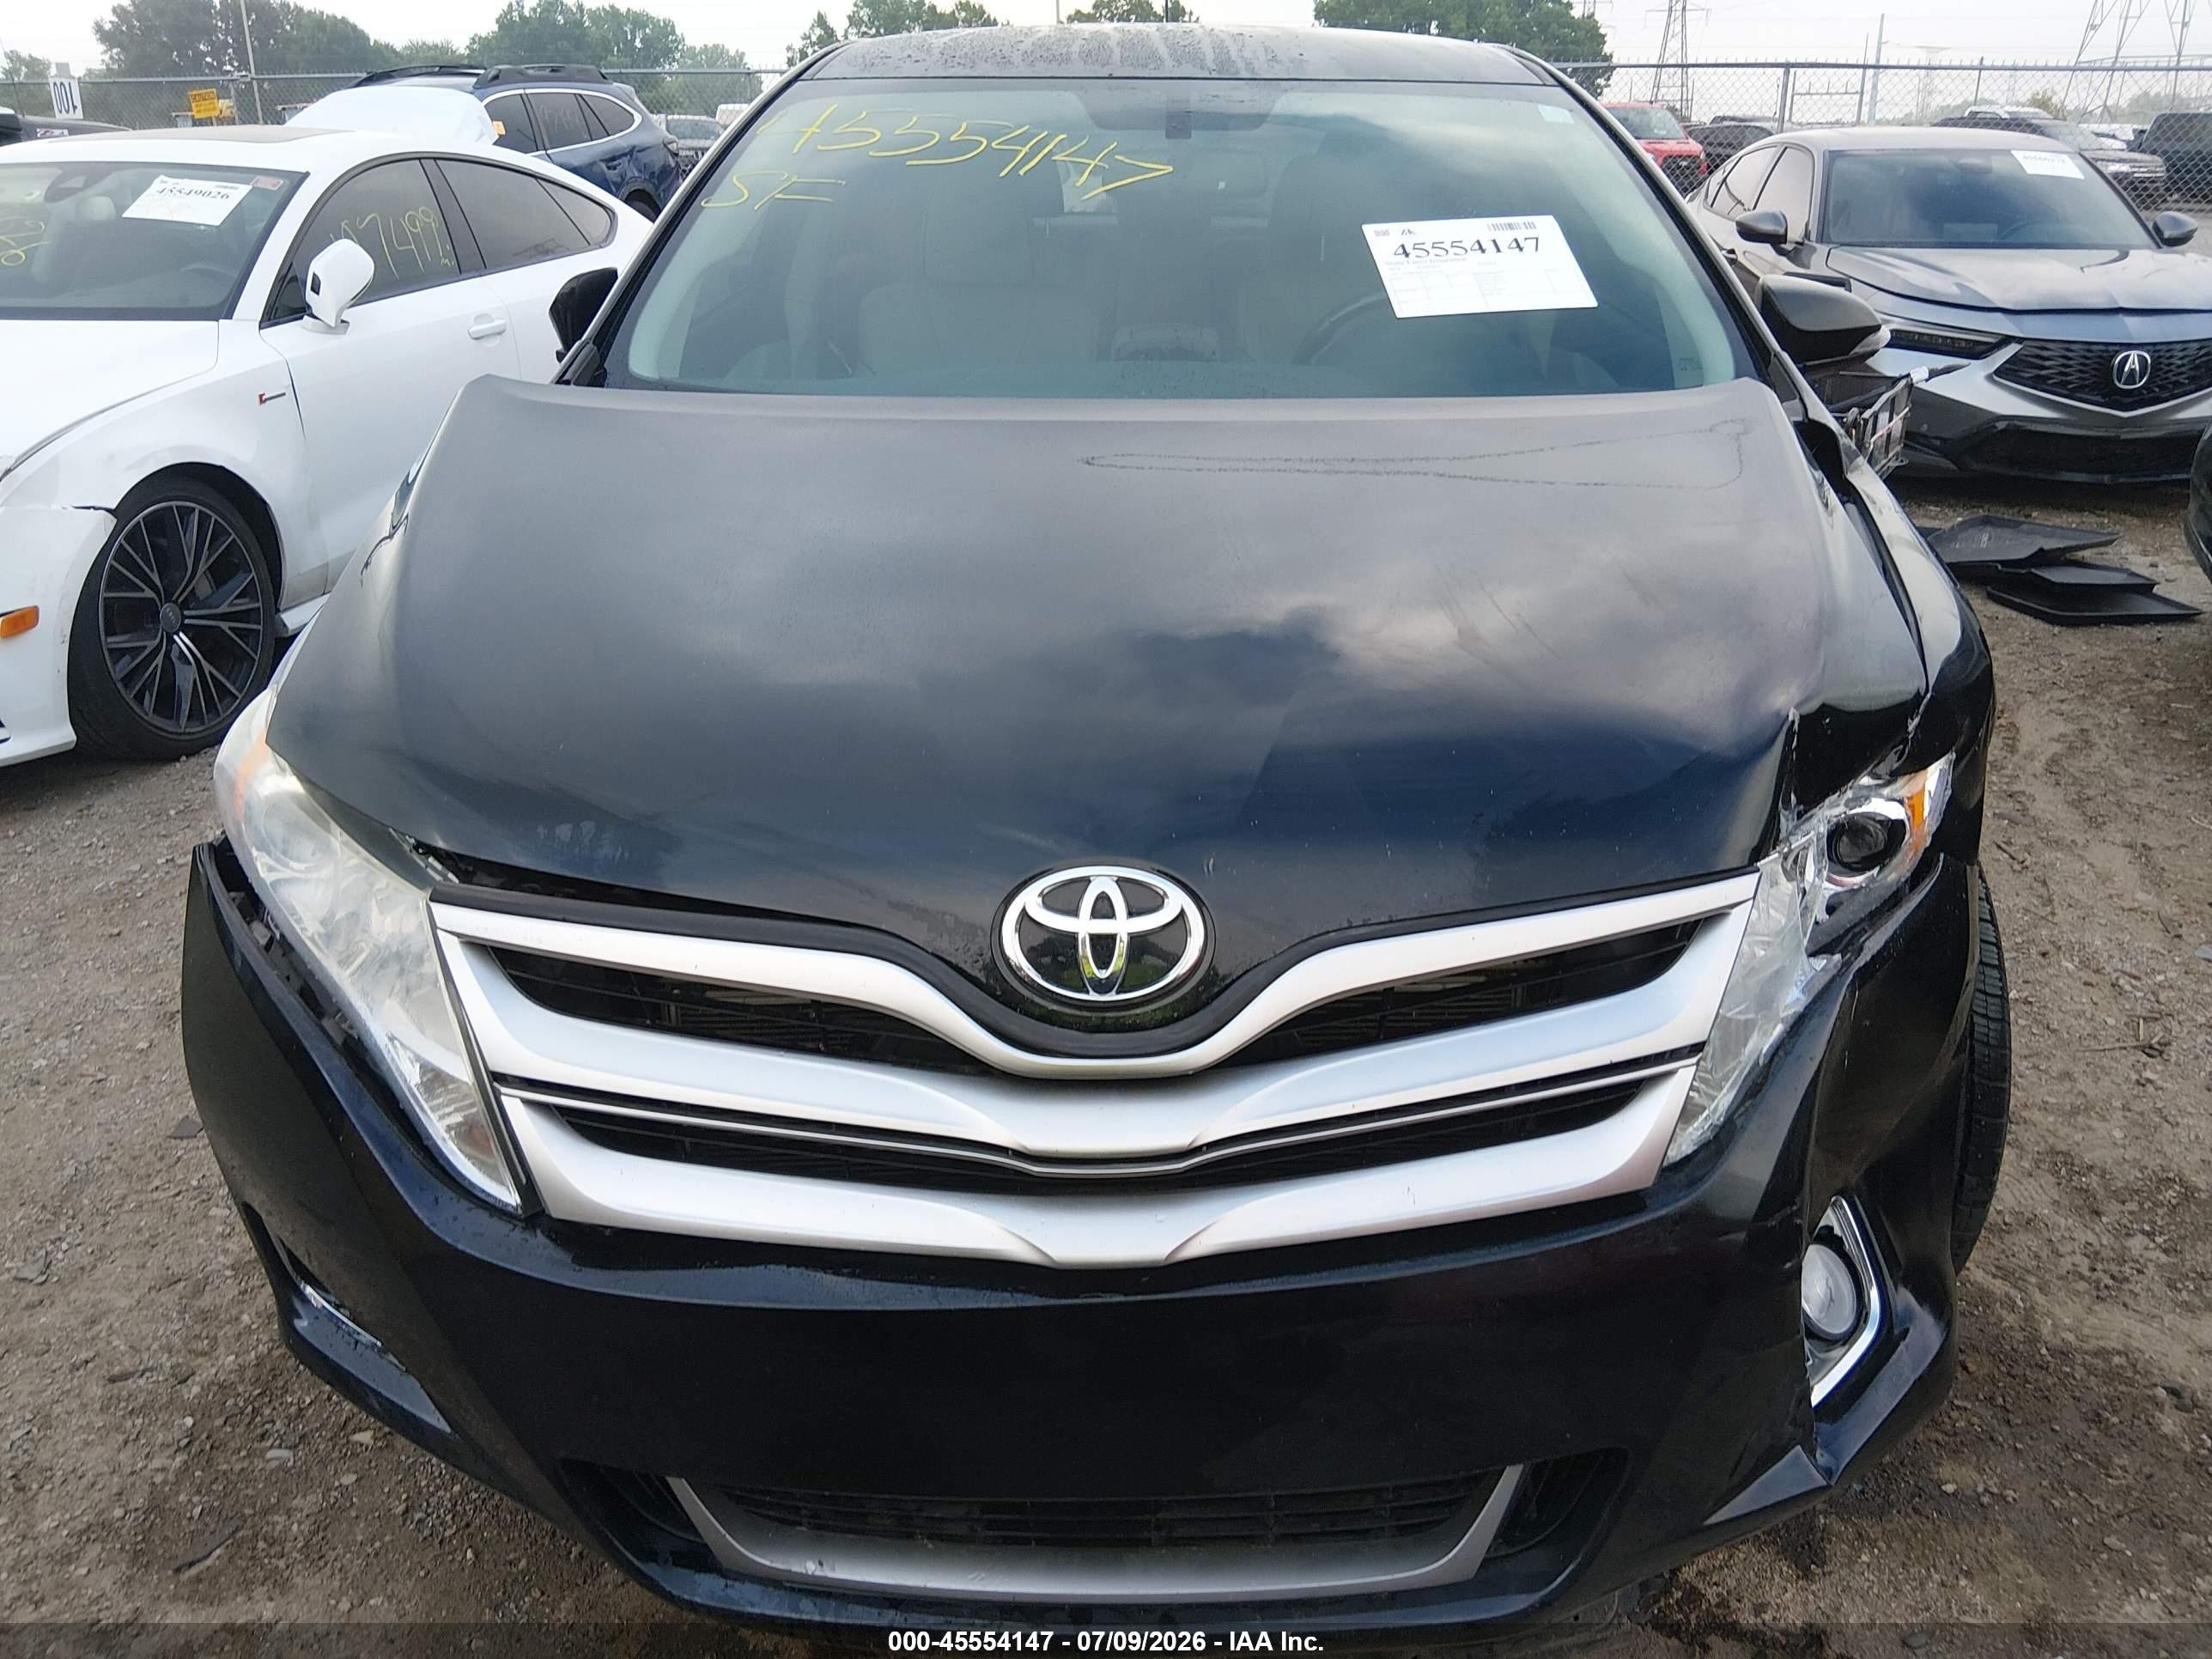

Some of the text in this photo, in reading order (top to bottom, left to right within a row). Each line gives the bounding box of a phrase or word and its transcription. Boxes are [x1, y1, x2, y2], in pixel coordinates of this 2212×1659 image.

[52, 81, 78, 115] 100
[756, 102, 1174, 201] 45554147
[700, 170, 848, 211] SF
[1394, 236, 1540, 258] 45554147
